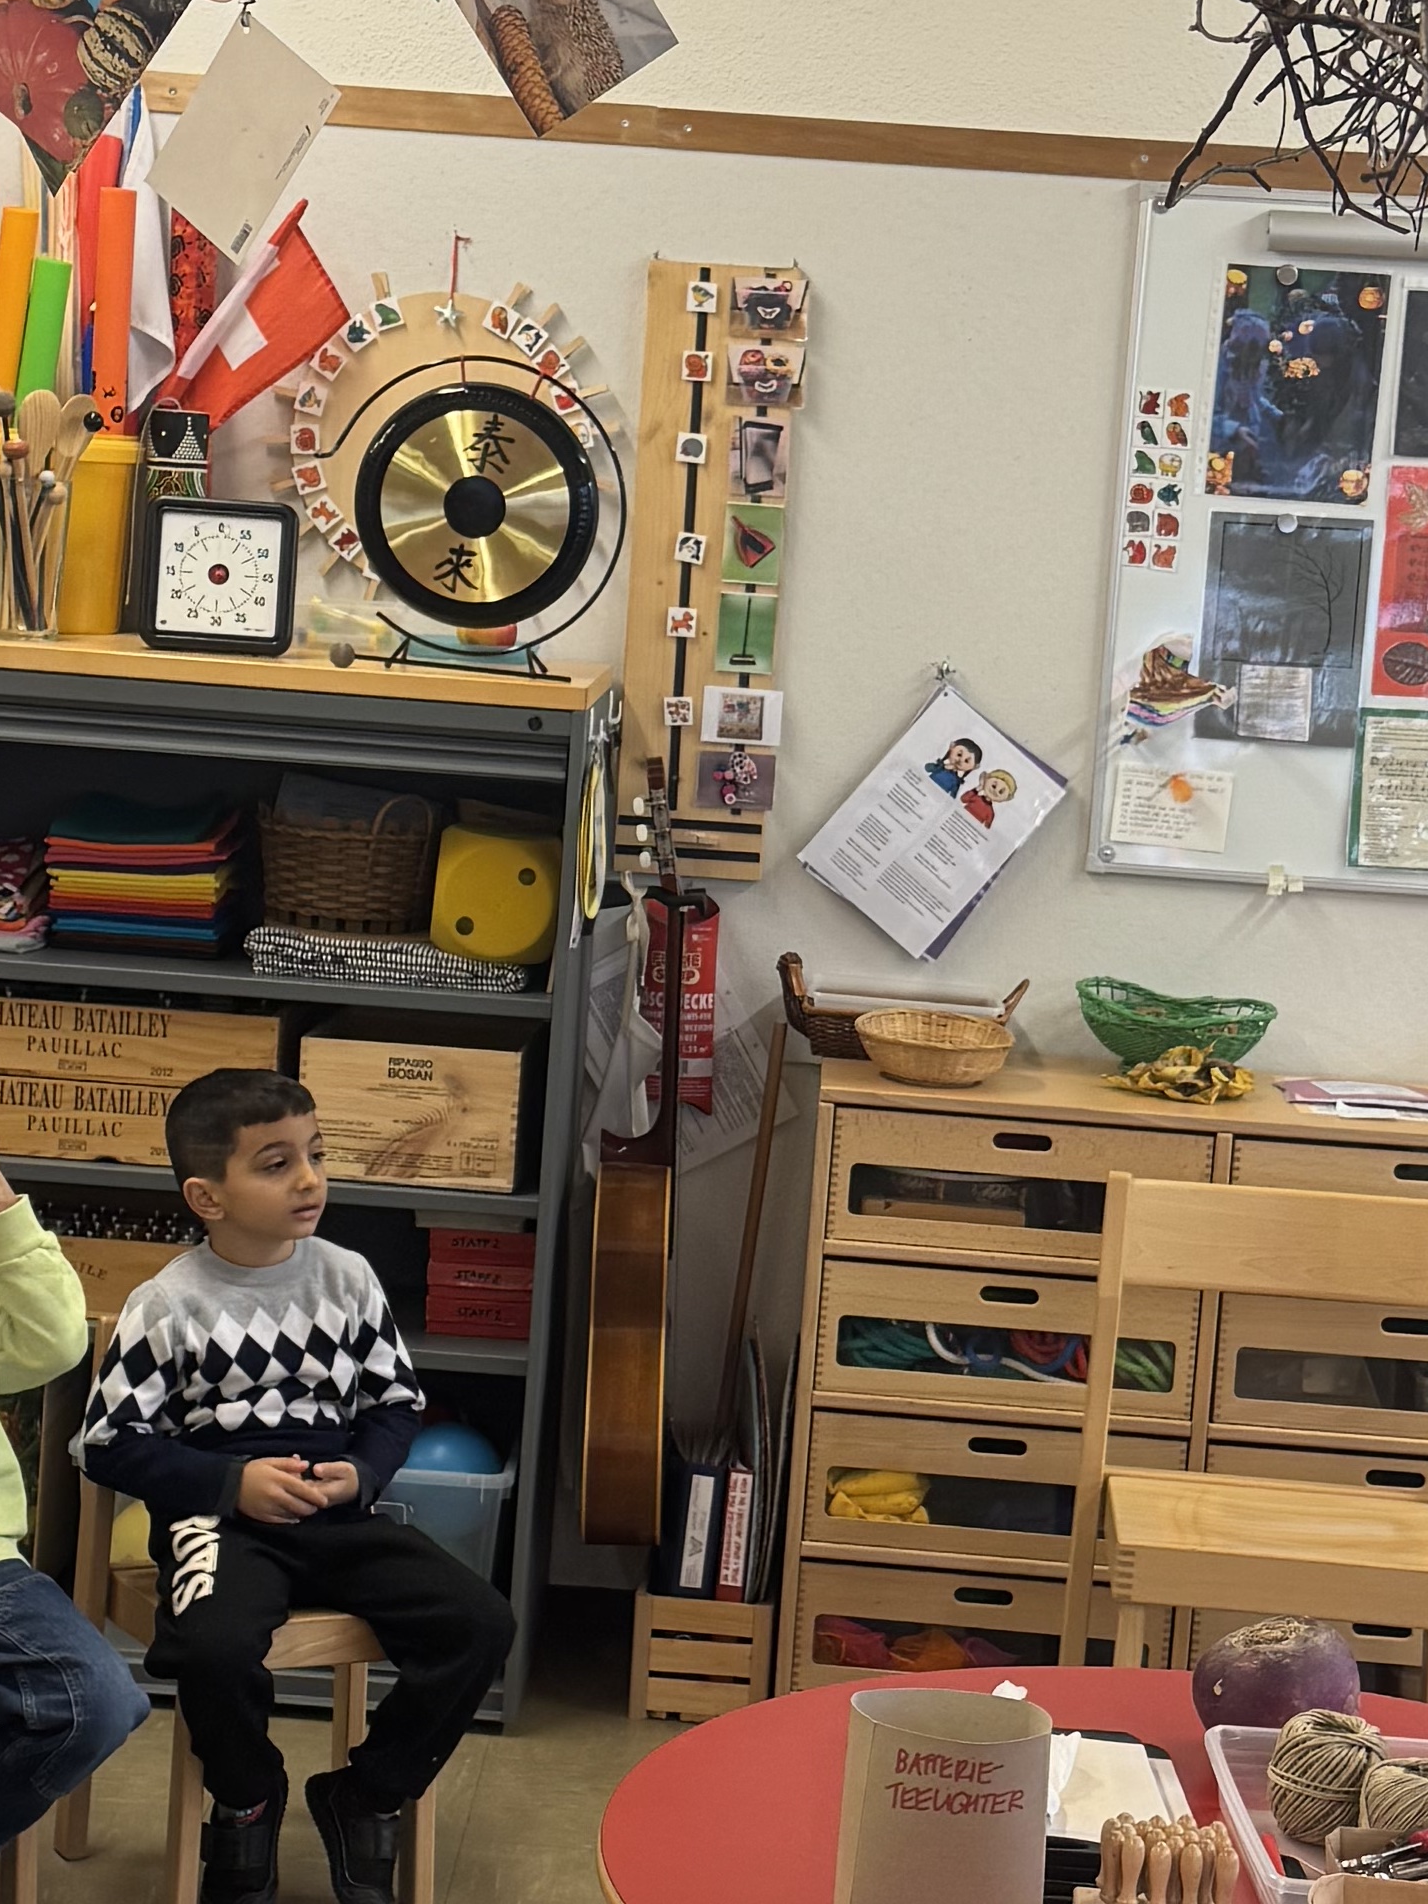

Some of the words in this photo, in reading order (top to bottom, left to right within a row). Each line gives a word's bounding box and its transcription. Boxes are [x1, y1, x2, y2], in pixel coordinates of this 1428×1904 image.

[73, 1006, 172, 1039] BATAILLEY
[26, 1034, 123, 1059] PAUILLAC
[149, 1066, 174, 1078] 2012
[73, 1085, 172, 1118] BATAILLEY
[26, 1114, 124, 1138] PAUILLAC
[894, 1747, 1005, 1785] BATTERIE-
